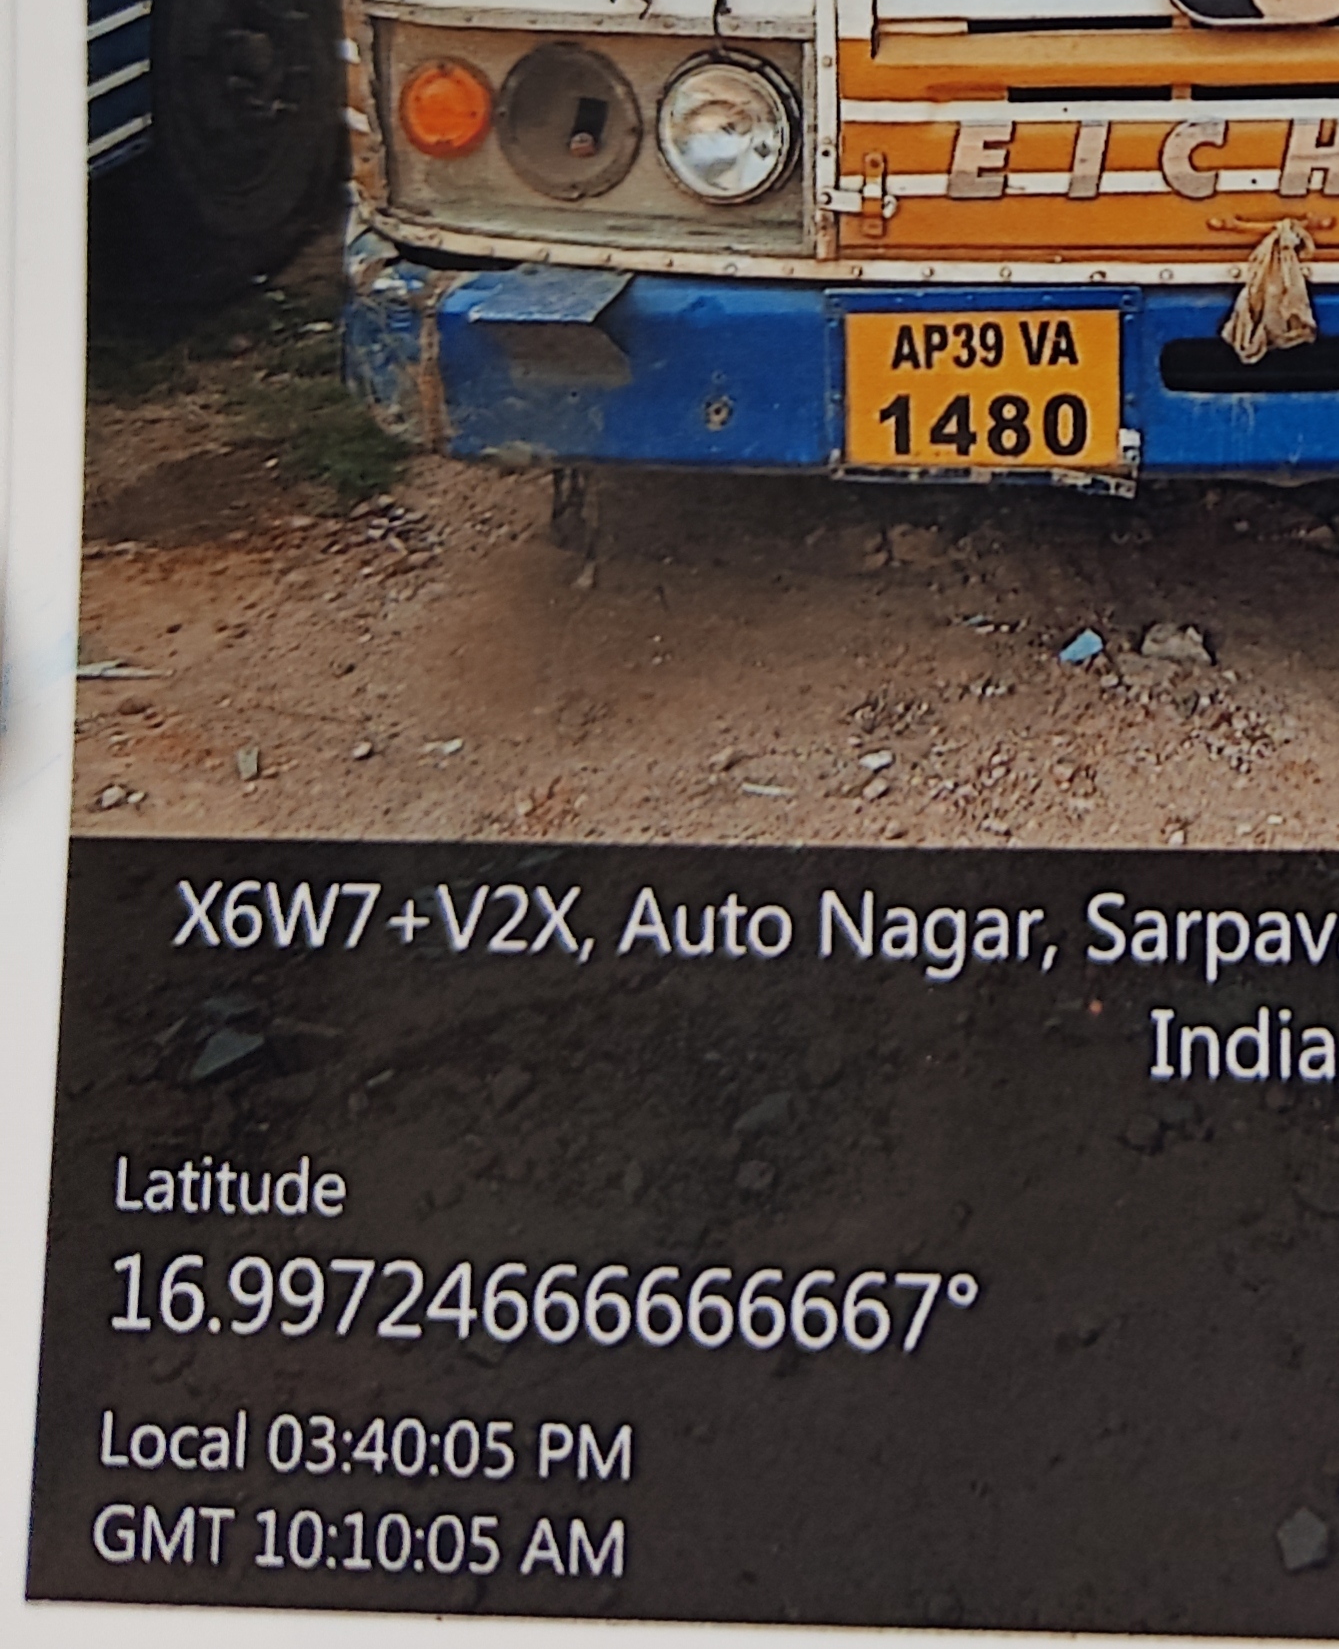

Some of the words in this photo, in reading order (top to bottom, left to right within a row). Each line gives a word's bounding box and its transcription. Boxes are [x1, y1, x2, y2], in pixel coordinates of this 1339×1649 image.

[889, 320, 1004, 371] AP39
[1018, 318, 1080, 367] VA
[878, 391, 1089, 458] 1480
